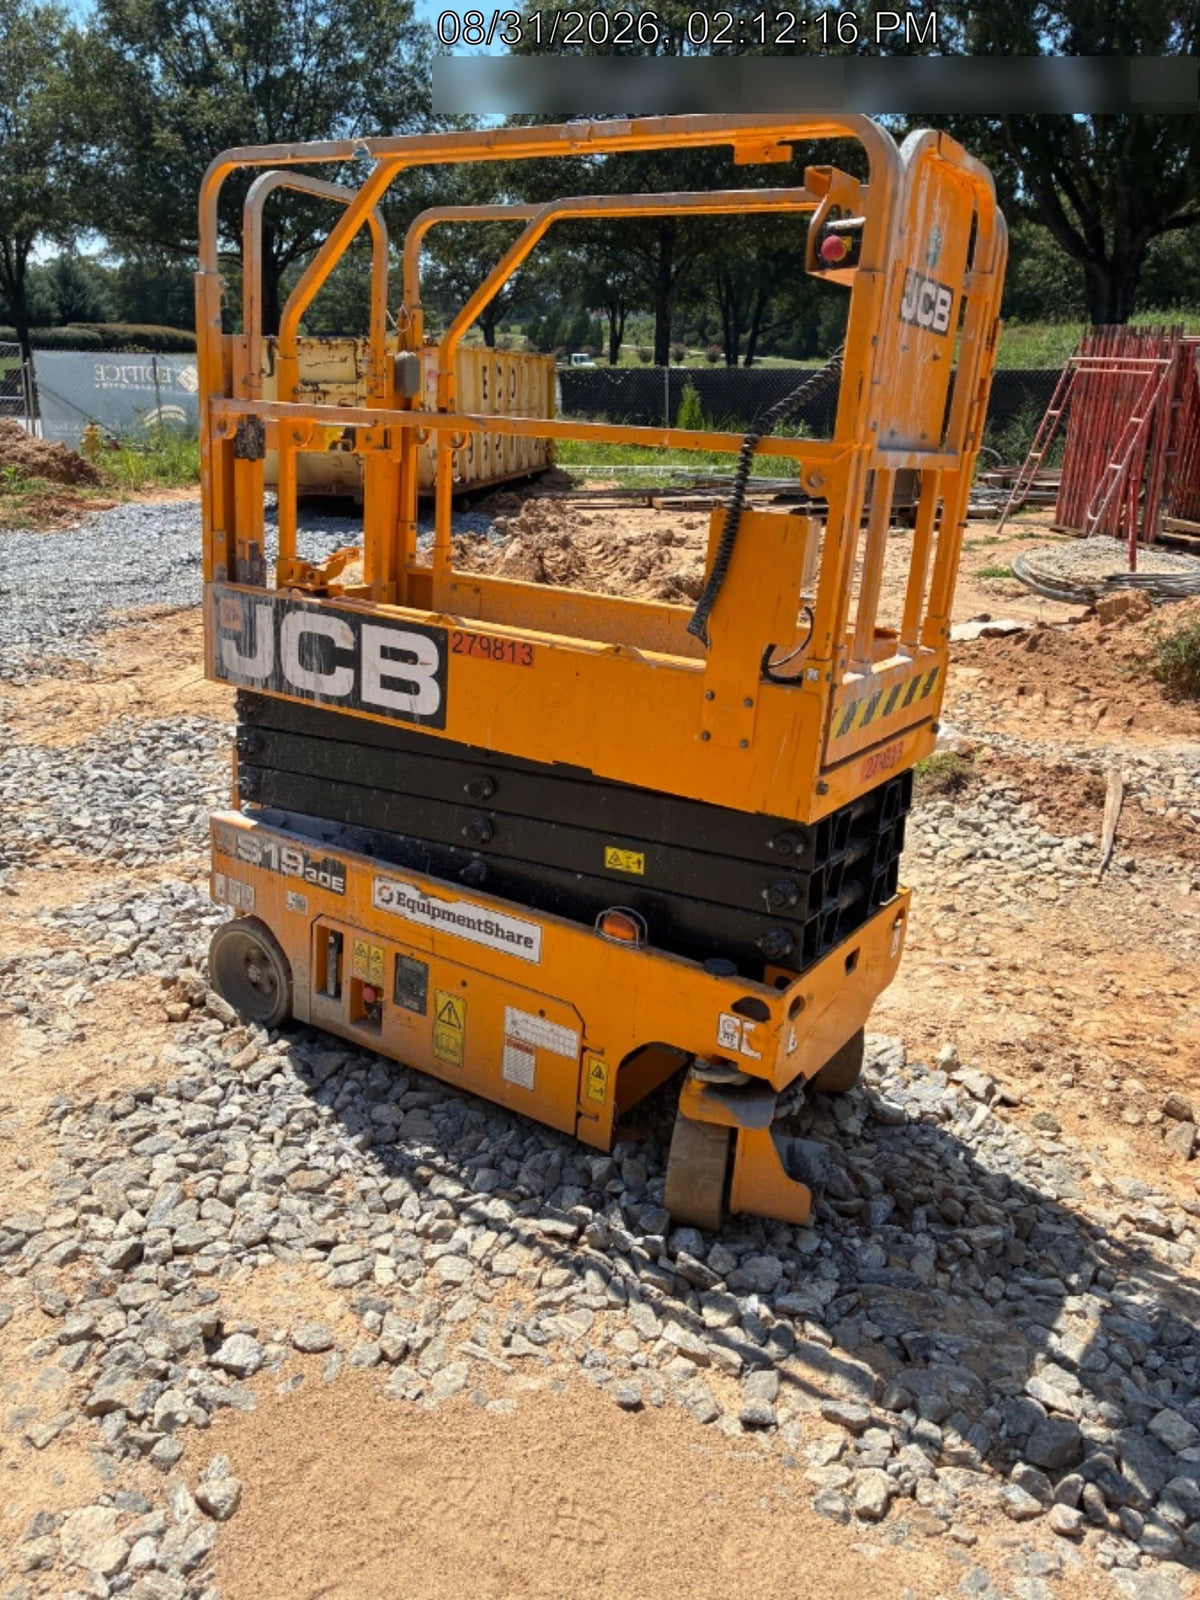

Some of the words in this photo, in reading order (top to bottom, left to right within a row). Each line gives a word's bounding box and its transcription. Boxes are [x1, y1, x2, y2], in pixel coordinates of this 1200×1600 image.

[901, 274, 953, 332] JCB
[221, 604, 440, 716] JCB
[452, 632, 534, 666] 279813
[396, 890, 534, 949] EquipmentShare
